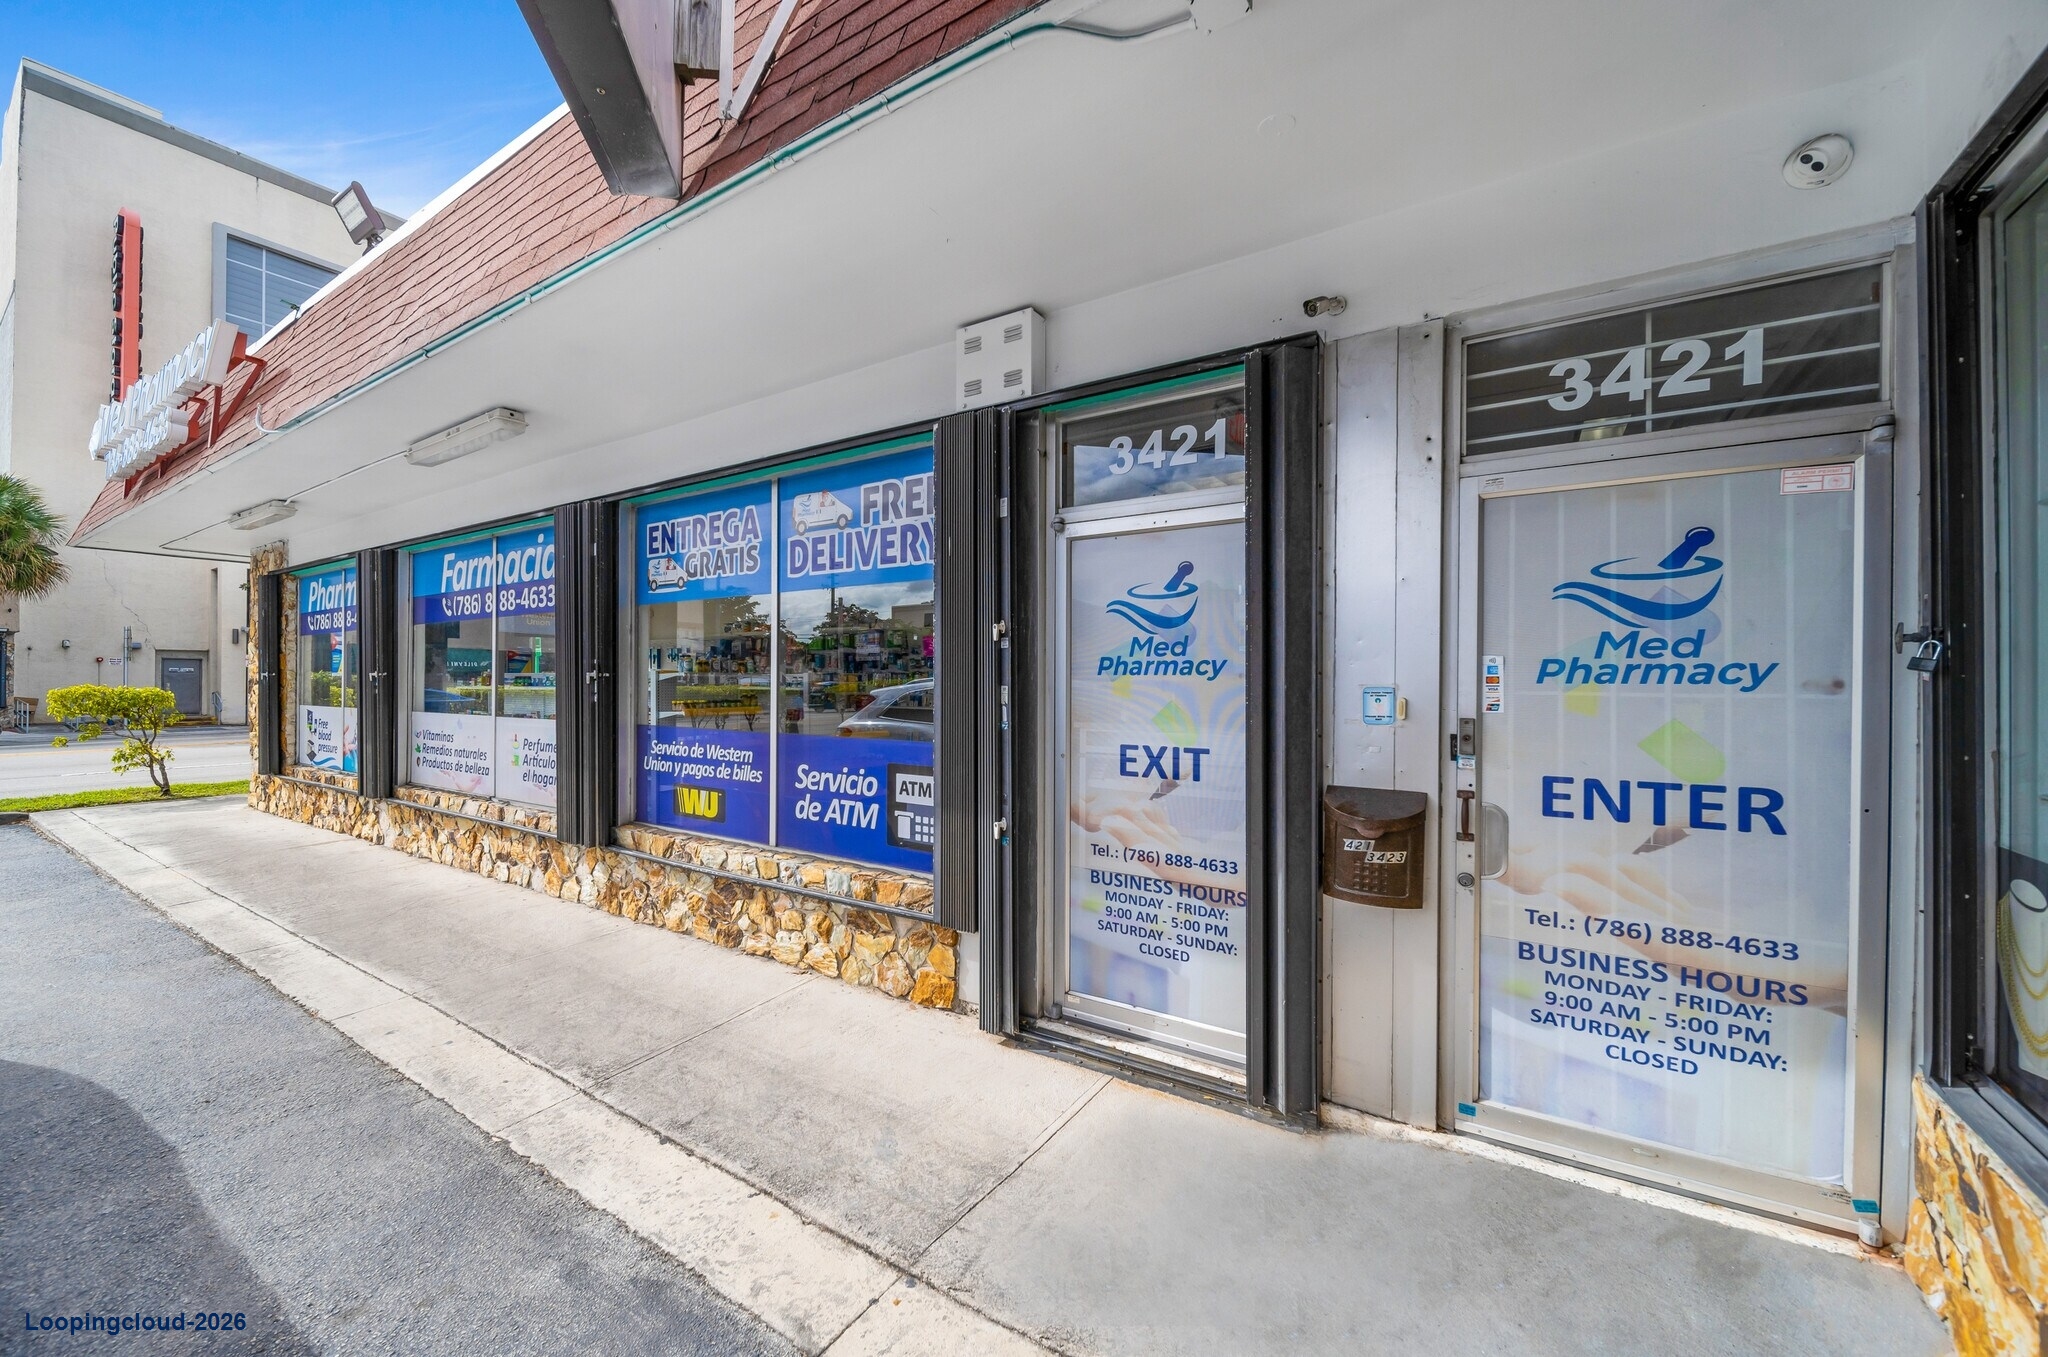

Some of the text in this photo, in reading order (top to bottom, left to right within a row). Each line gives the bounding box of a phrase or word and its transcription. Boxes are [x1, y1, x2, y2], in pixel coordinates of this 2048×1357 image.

[1547, 327, 1765, 412] 3421
[1108, 418, 1227, 476] 3421
[648, 506, 761, 556] ENTREGA
[441, 533, 556, 593] Farmacia
[686, 544, 760, 579] GRATIS
[453, 593, 482, 616] (786)
[313, 613, 332, 631] (786)
[1128, 635, 1189, 657] Med
[1594, 629, 1706, 659] Med
[1097, 655, 1228, 681] Pharmacy
[1536, 656, 1781, 693] Pharmacy
[318, 718, 329, 729] Free
[318, 730, 332, 741] blood
[422, 729, 454, 743] Vitaminas
[318, 743, 338, 754] pressure
[422, 743, 488, 761] Remedios naturales
[651, 740, 753, 763] Servicio de Western
[1119, 743, 1210, 782] EXIT
[422, 756, 490, 776] Productos de belleza
[522, 769, 530, 783] el
[643, 756, 763, 783] Union y pagos de billes
[795, 764, 878, 797] Servicio
[681, 788, 720, 819] WU
[899, 780, 932, 798] ATM
[795, 793, 879, 830] de ATM
[1542, 775, 1788, 836] ENTER
[1091, 843, 1239, 875] Tel.: (786) 888-4633
[1346, 840, 1371, 851] 421
[1367, 852, 1404, 862] 3423
[1090, 869, 1246, 907] BUSINESS HOURS
[1105, 890, 1164, 910] MONDAY
[1176, 902, 1229, 922] FRIDAY:
[1105, 906, 1132, 920] 9:00
[1135, 910, 1159, 925] AM
[1171, 917, 1200, 932] 5:00
[1205, 923, 1228, 938] PM
[1097, 919, 1164, 941] SATURDAY
[1176, 934, 1238, 956] SUNDAY:
[1524, 908, 1799, 961] Tel.: (786) 888-4633
[1139, 943, 1190, 963] CLOSED
[1518, 941, 1809, 1006] BUSINESS HOURS
[1544, 970, 1651, 1001] MONDAY
[1675, 992, 1773, 1024] FRIDAY:
[1545, 991, 1593, 1012] 9:00
[1600, 1000, 1640, 1022] AM
[1665, 1013, 1718, 1036] 5:00
[1727, 1023, 1771, 1046] PM
[1530, 1008, 1650, 1044] SATURDAY
[1673, 1036, 1788, 1073] SUNDAY:
[1605, 1044, 1699, 1076] CLOSED
